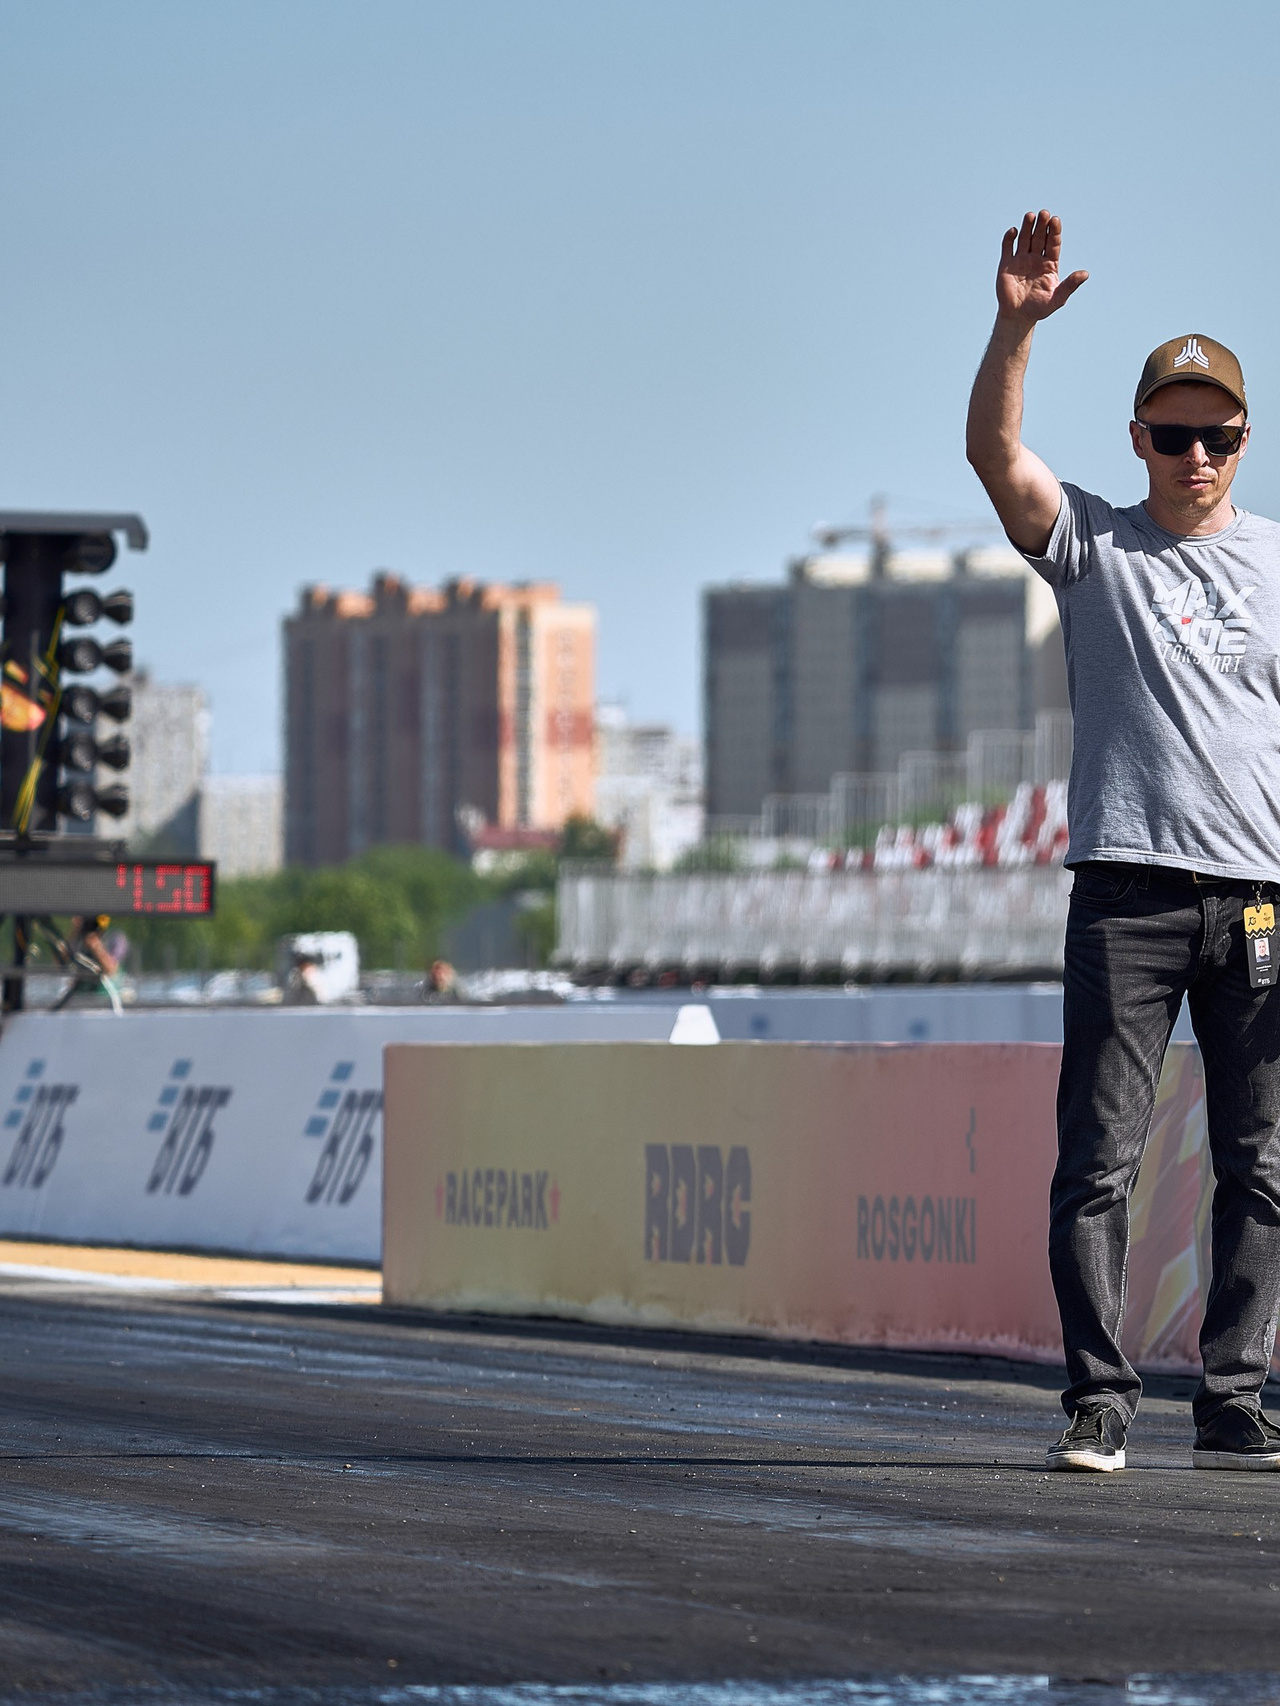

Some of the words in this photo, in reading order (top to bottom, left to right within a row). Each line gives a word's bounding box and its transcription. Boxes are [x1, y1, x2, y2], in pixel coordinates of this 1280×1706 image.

[1152, 576, 1257, 620] MAX
[146, 1085, 233, 1196] ВТБ
[446, 1168, 549, 1230] RACEPARK
[644, 1143, 752, 1267] RDRC
[857, 1195, 977, 1265] ROSGONKI
